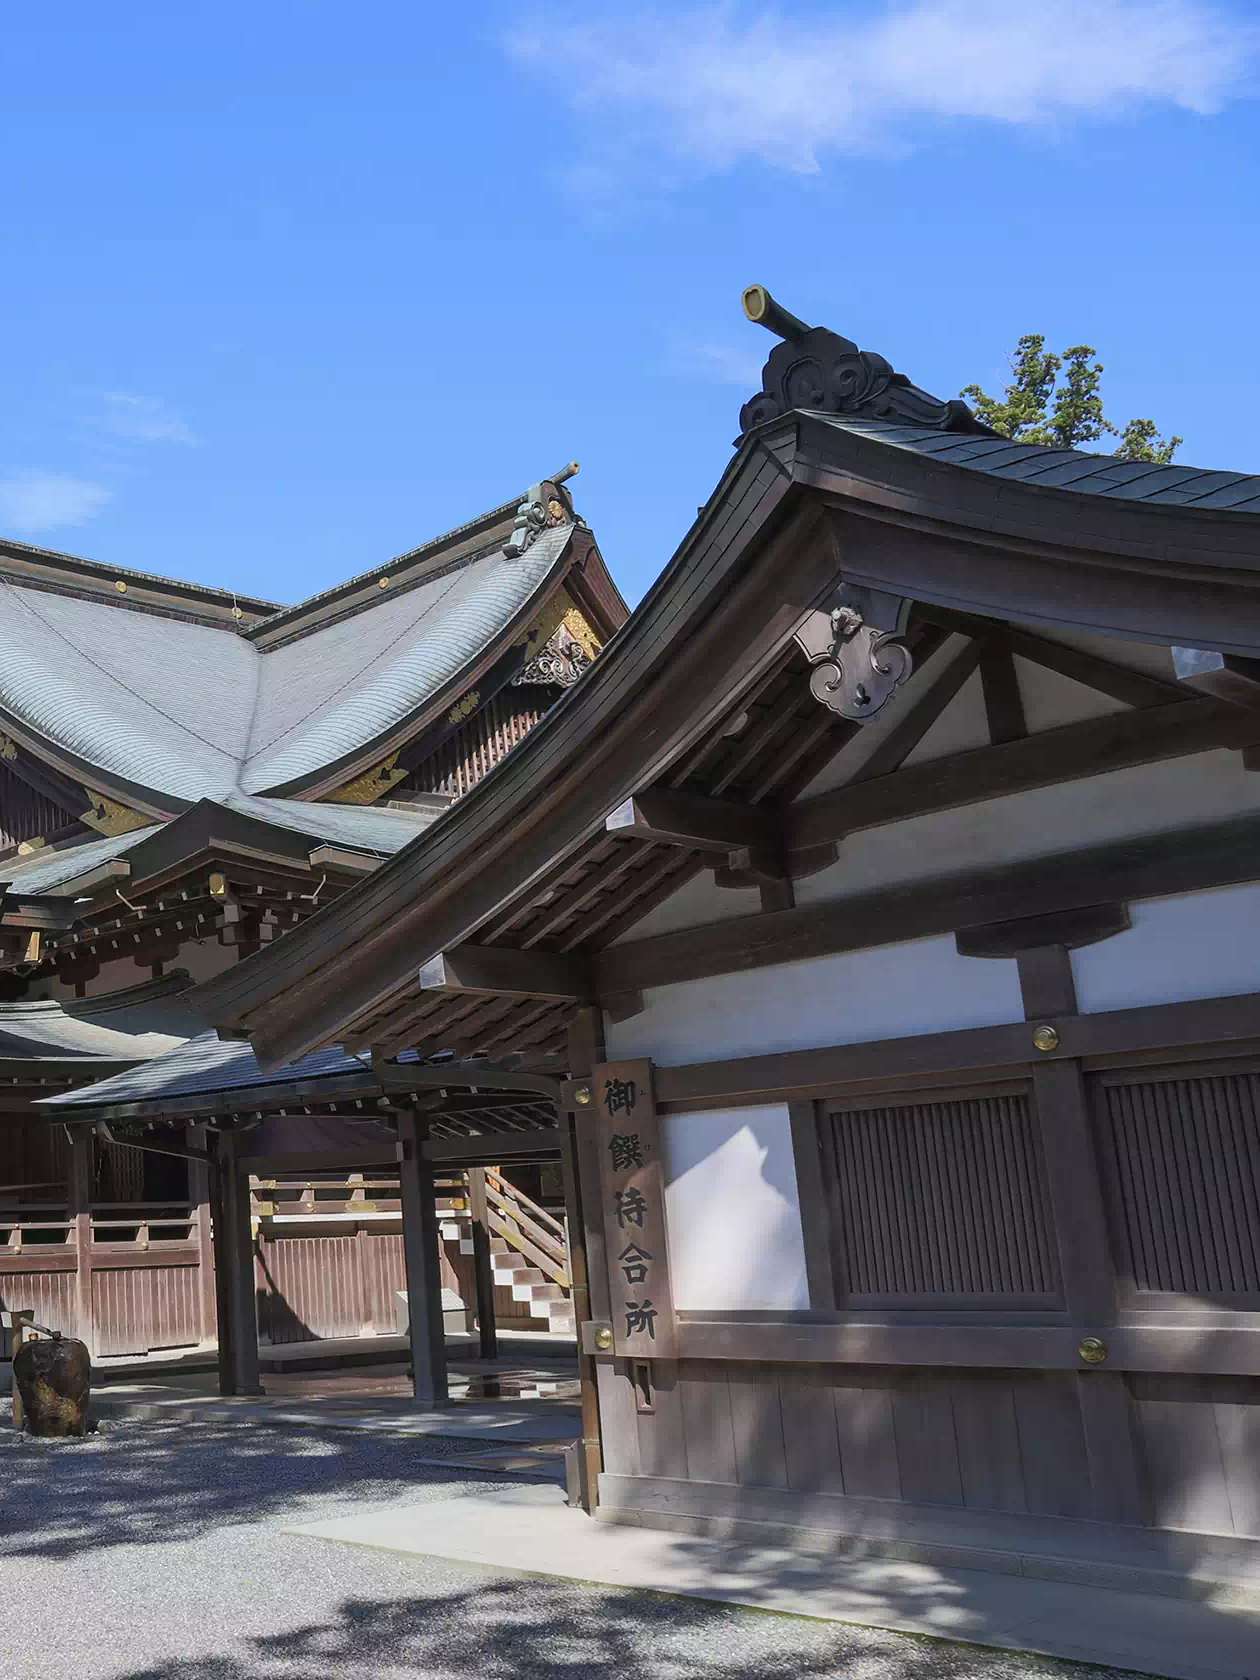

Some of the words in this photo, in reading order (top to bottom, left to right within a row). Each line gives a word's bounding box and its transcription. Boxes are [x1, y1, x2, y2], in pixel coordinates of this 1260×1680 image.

[604, 1078, 658, 1341] 御饌待合所
